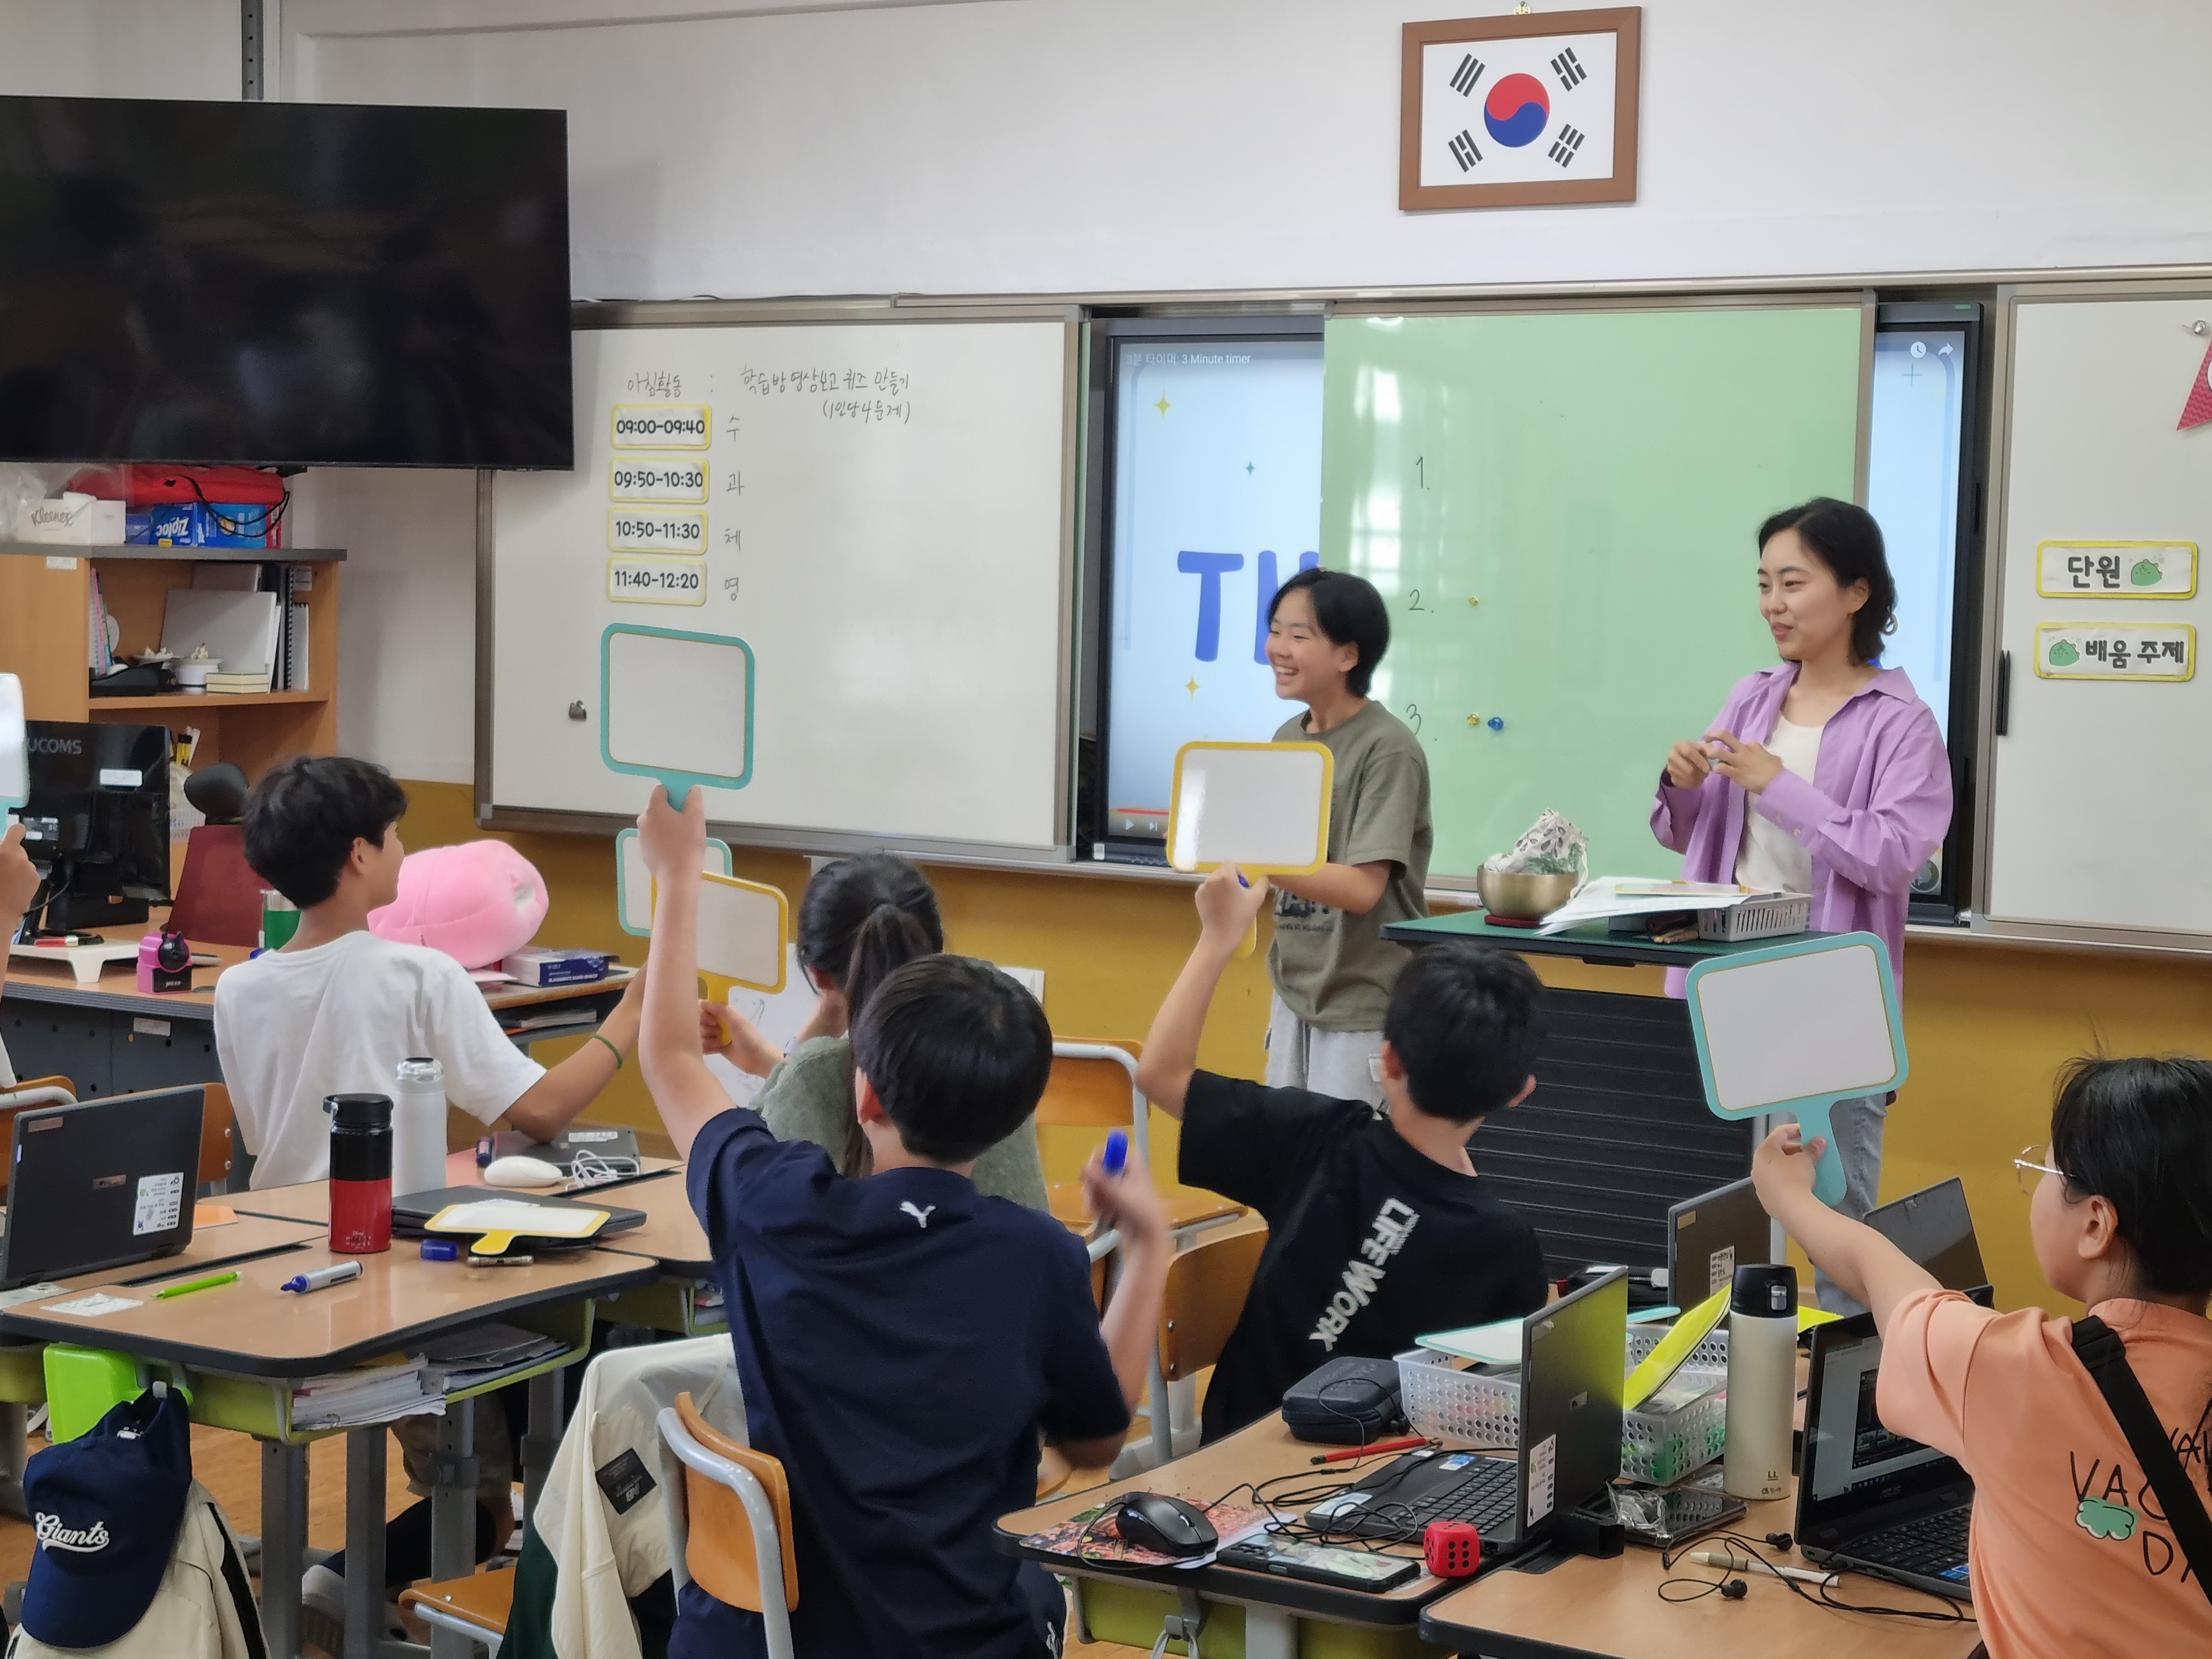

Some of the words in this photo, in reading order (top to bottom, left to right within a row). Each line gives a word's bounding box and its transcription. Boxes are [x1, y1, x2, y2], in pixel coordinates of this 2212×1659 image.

[1146, 352, 1179, 366] 타이머:
[1182, 354, 1188, 364] 3
[1190, 354, 1223, 364] Minute
[1226, 353, 1251, 364] timer
[628, 370, 682, 398] 아침활동
[616, 419, 705, 435] 09:00-09:40
[726, 415, 741, 441] 수
[614, 470, 704, 488] 09:50-10:30
[726, 471, 745, 496] 과
[31, 507, 74, 527] Kleenex
[156, 516, 189, 538] Ziploc
[615, 520, 701, 539] 10:50-11:30
[724, 528, 742, 552] 체
[614, 571, 699, 590] 11:40-12:20
[2067, 556, 2121, 589] 단원
[725, 577, 740, 601] 영
[1177, 550, 1319, 665] TI
[2085, 640, 2131, 669] 배움
[2136, 639, 2185, 665] 주제
[1360, 1197, 1421, 1267] LIFE
[1308, 1259, 1386, 1352] WORK
[35, 1511, 110, 1553] Giants
